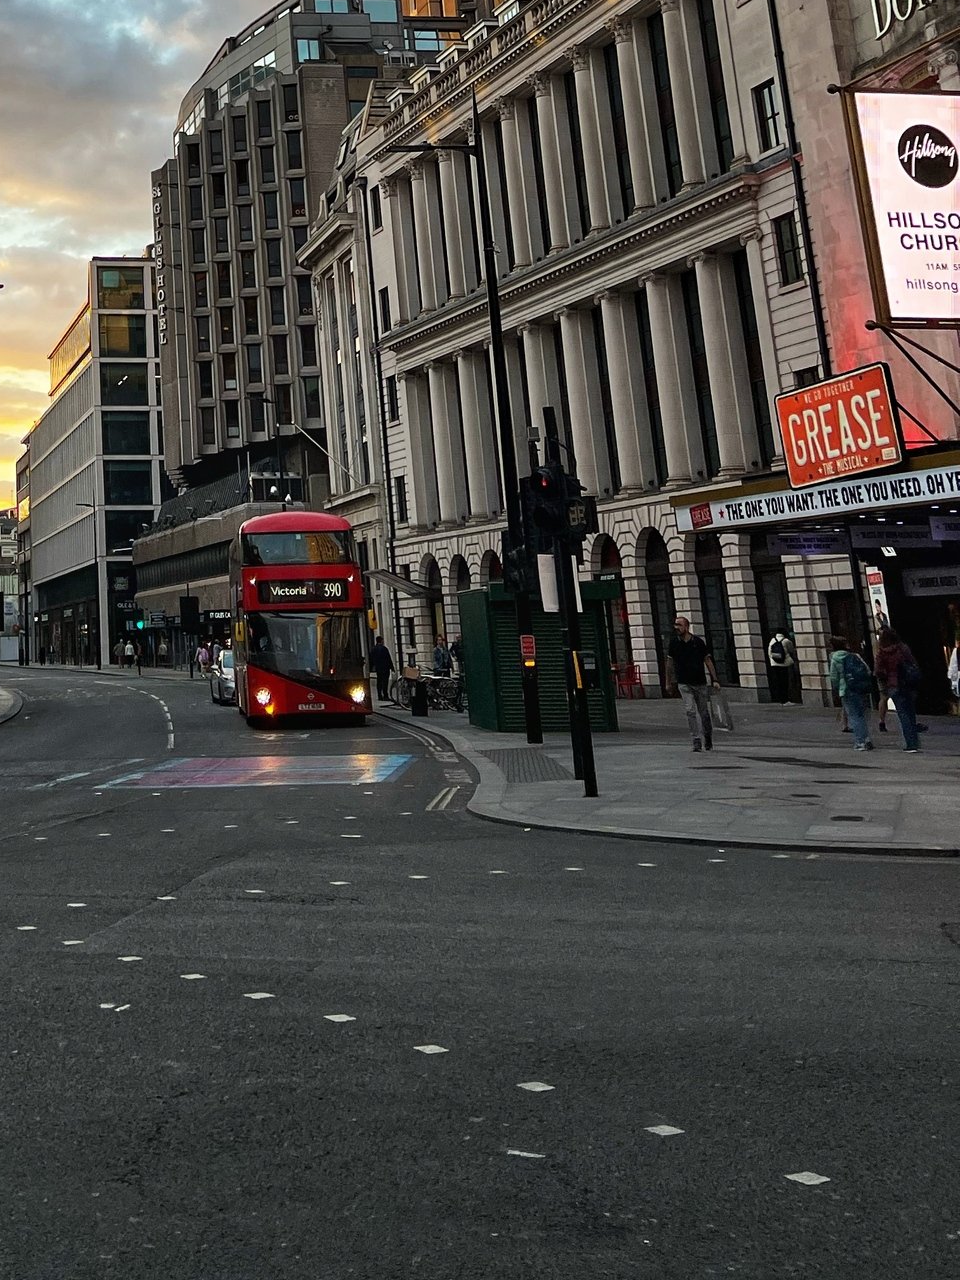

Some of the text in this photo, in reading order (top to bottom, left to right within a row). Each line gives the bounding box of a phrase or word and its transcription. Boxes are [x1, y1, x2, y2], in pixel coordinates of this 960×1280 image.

[900, 133, 955, 177] Hillsong
[887, 212, 960, 229] HILLSO
[900, 233, 960, 250] CHUR
[906, 279, 958, 293] hillsong
[788, 388, 890, 466] GREASE
[822, 455, 864, 475] THE MUSICAL
[725, 502, 745, 521] THE
[745, 499, 765, 518] ONE
[764, 496, 785, 515] YOU
[785, 492, 818, 513] WANT.
[818, 489, 841, 508] THE
[840, 485, 864, 505] ONE
[864, 482, 889, 502] YOU
[888, 477, 926, 499] NEED.
[926, 474, 946, 495] OH
[270, 582, 342, 597] Victoria 390
